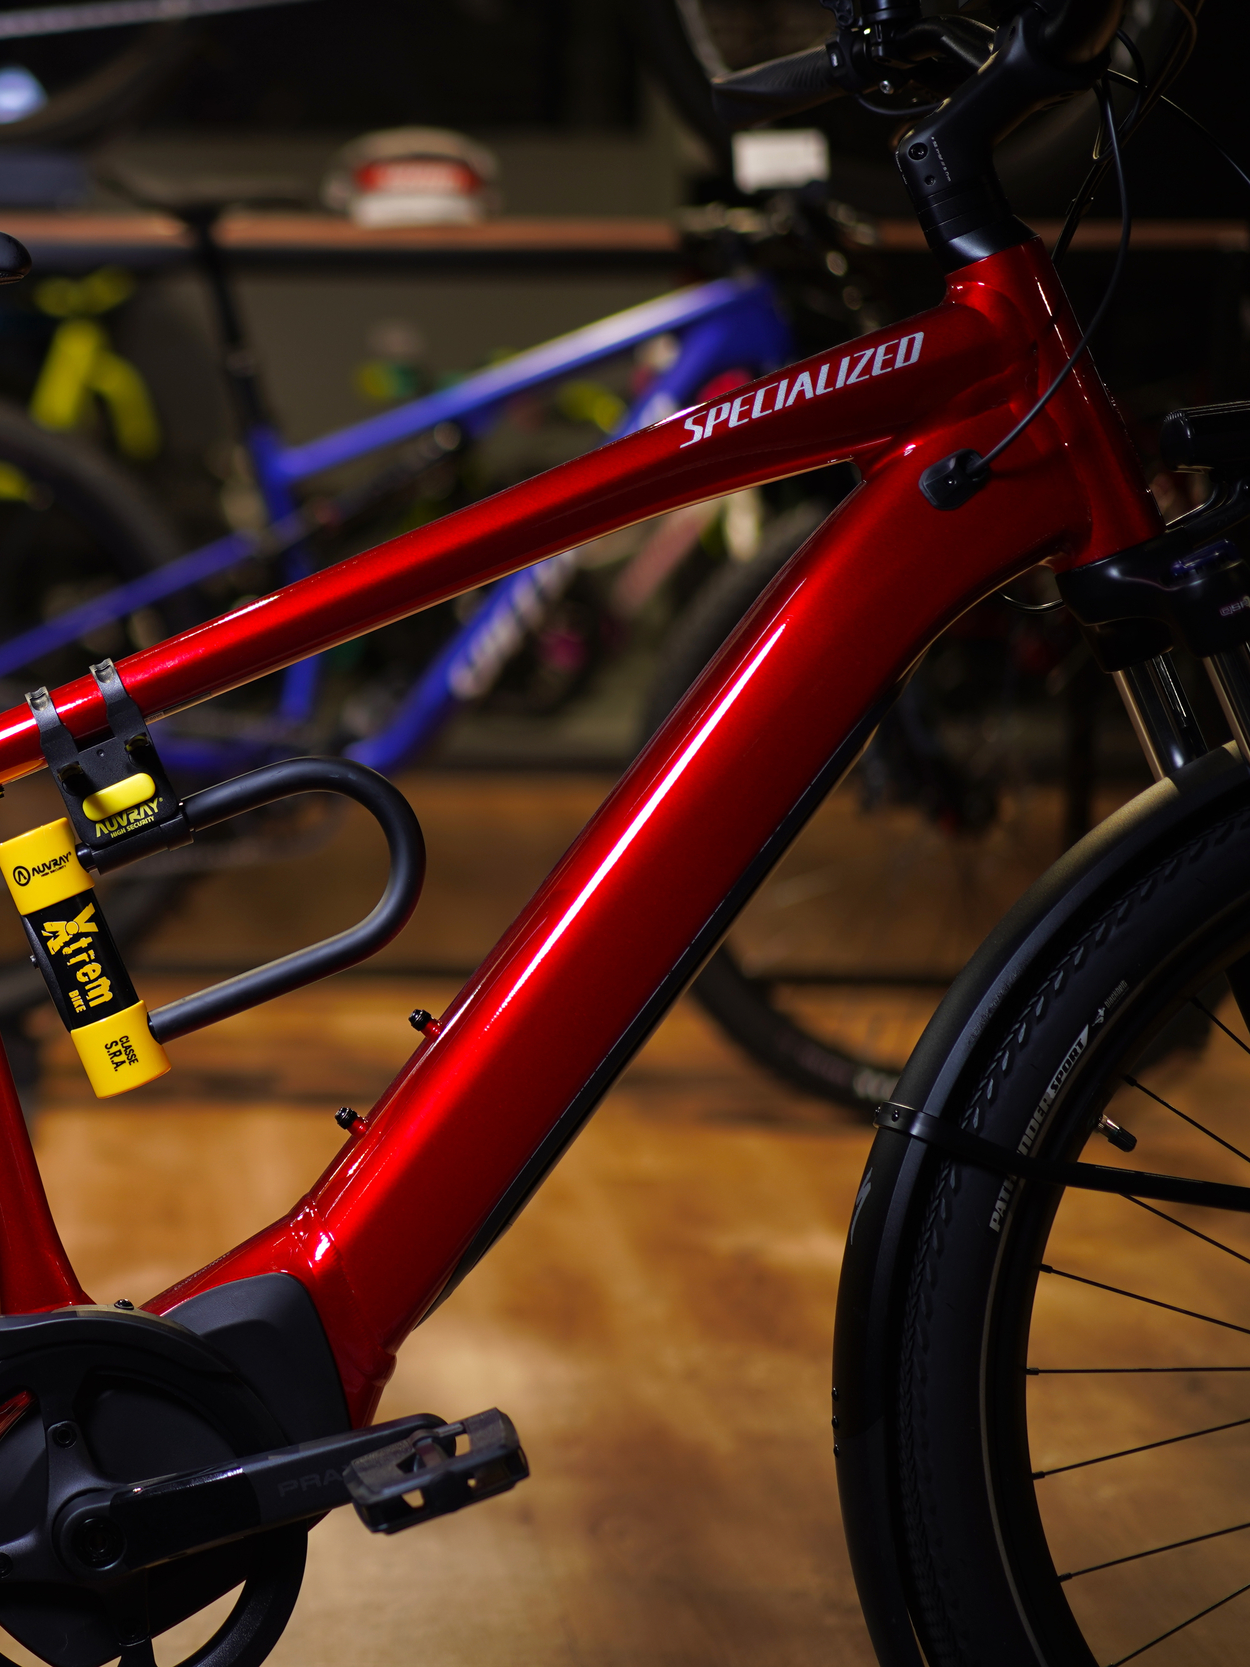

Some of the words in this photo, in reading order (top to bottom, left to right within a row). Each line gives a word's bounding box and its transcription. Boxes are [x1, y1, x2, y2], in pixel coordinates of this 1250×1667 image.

[679, 331, 925, 449] SPECIALIZED
[95, 801, 161, 837] AUVRAY
[111, 827, 126, 838] HIGH
[126, 815, 155, 832] SECURITY
[32, 853, 70, 877] AUVRAY
[68, 989, 87, 1013] BIKE
[104, 1040, 127, 1072] S.R.A.
[118, 1035, 139, 1066] CLASSE
[1050, 1038, 1086, 1094] SPORT
[276, 1463, 351, 1497] PRA
